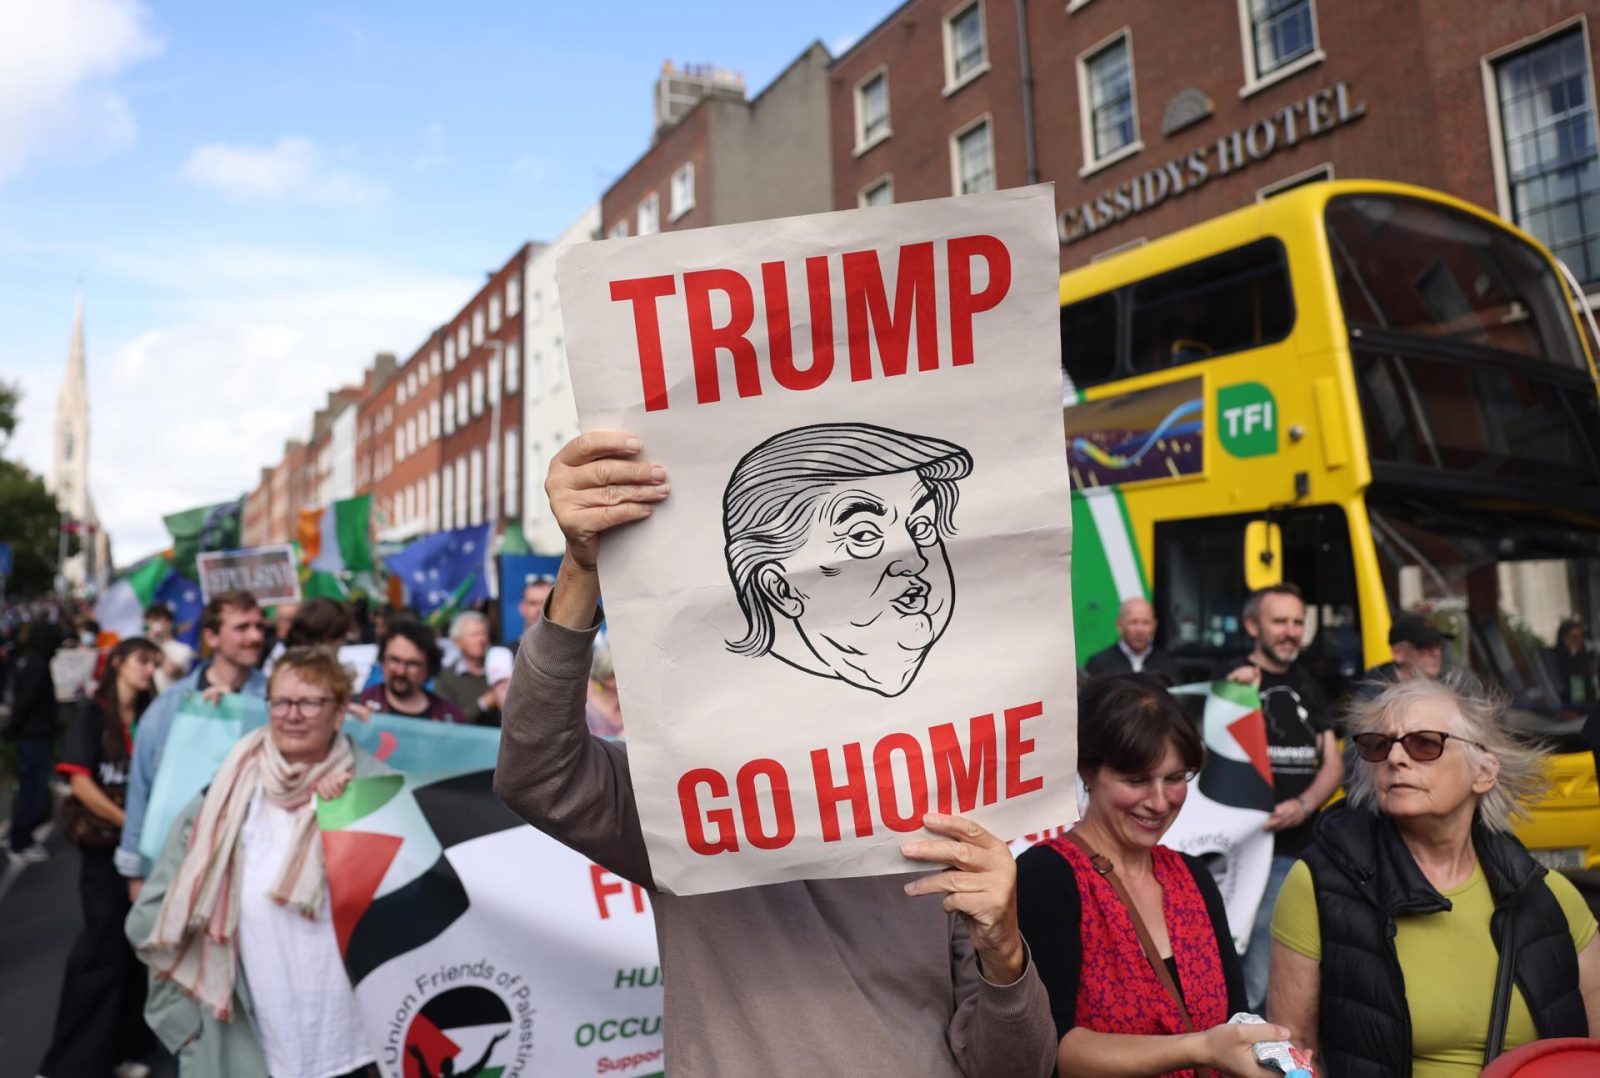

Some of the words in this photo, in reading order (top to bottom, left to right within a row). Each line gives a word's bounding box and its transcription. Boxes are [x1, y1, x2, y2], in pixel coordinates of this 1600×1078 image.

[1058, 148, 1209, 243] CASSIDYS
[1216, 81, 1366, 173] HOTEL
[609, 234, 1012, 412] TRUMP
[1223, 401, 1273, 438] TFI
[677, 758, 796, 856] GO
[810, 701, 1044, 843] HOME
[383, 994, 417, 1066] Union
[414, 958, 496, 996] Friends
[496, 970, 521, 989] of
[614, 965, 664, 989] HU
